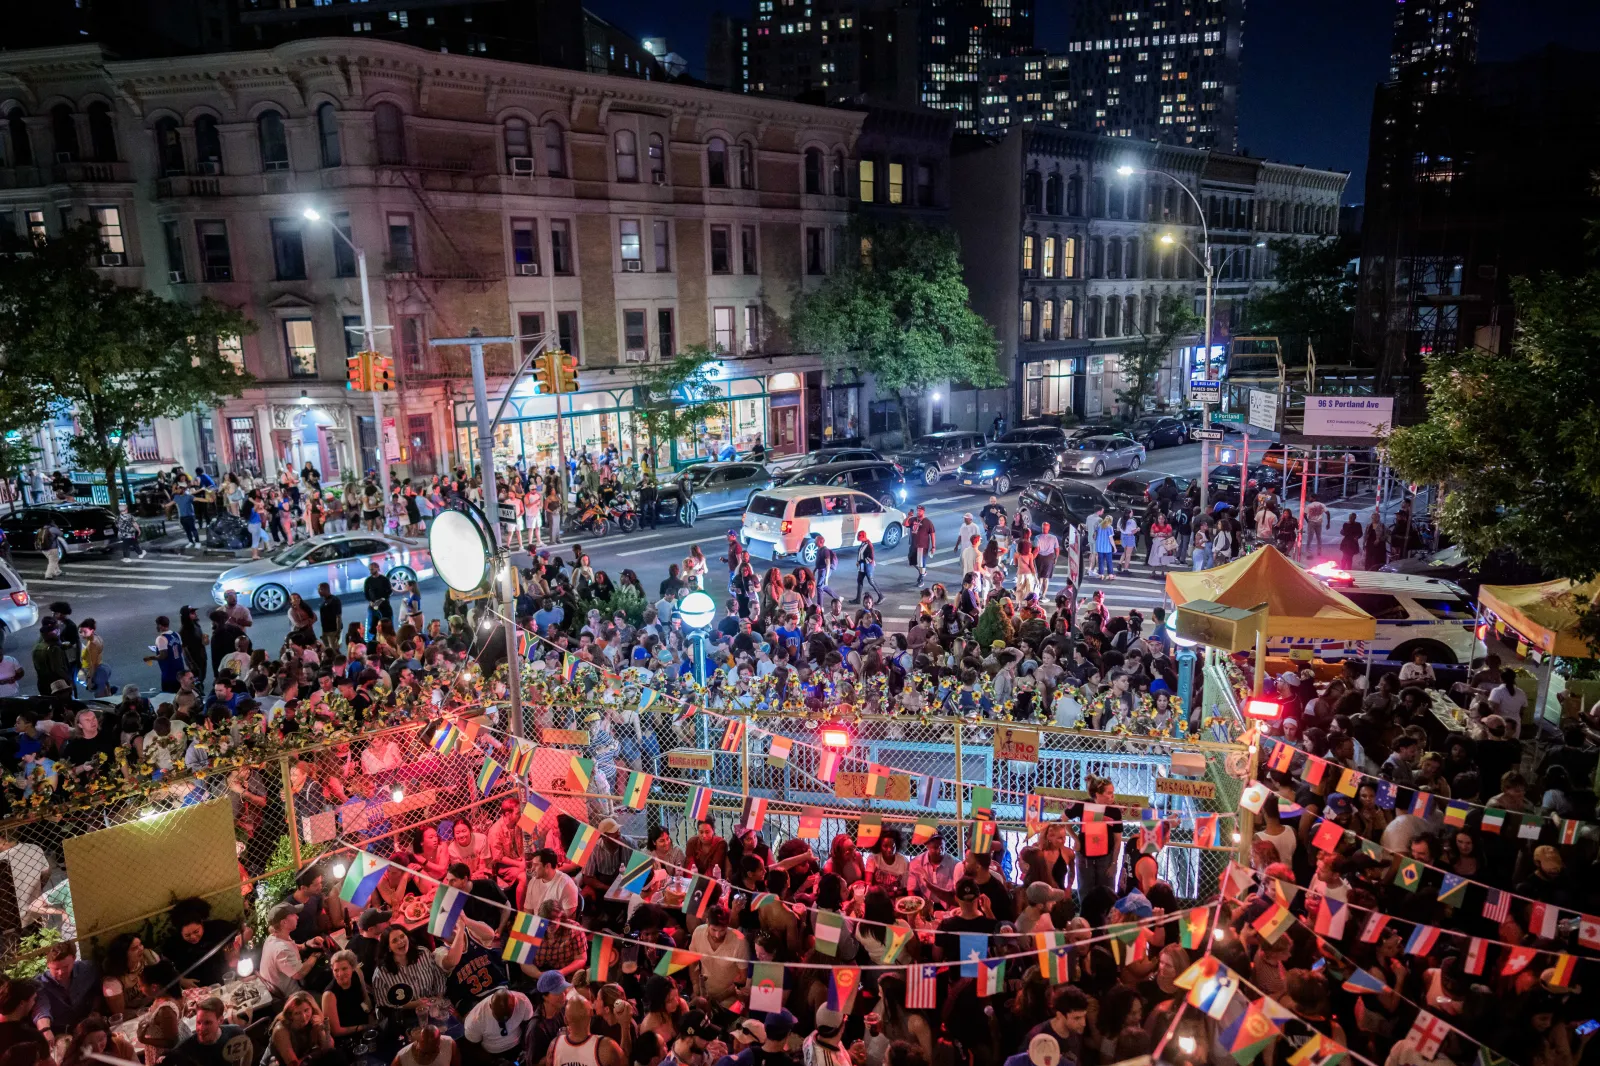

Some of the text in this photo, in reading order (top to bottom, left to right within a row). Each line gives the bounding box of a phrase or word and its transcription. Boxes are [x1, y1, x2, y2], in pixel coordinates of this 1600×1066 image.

[1318, 399, 1379, 409] 96 S Portland Ave
[1016, 743, 1034, 753] NO
[996, 752, 1036, 763] SMOKING
[1192, 784, 1214, 797] WAY
[467, 967, 493, 995] 33
[395, 988, 406, 1001] 3
[226, 1040, 247, 1055] 121
